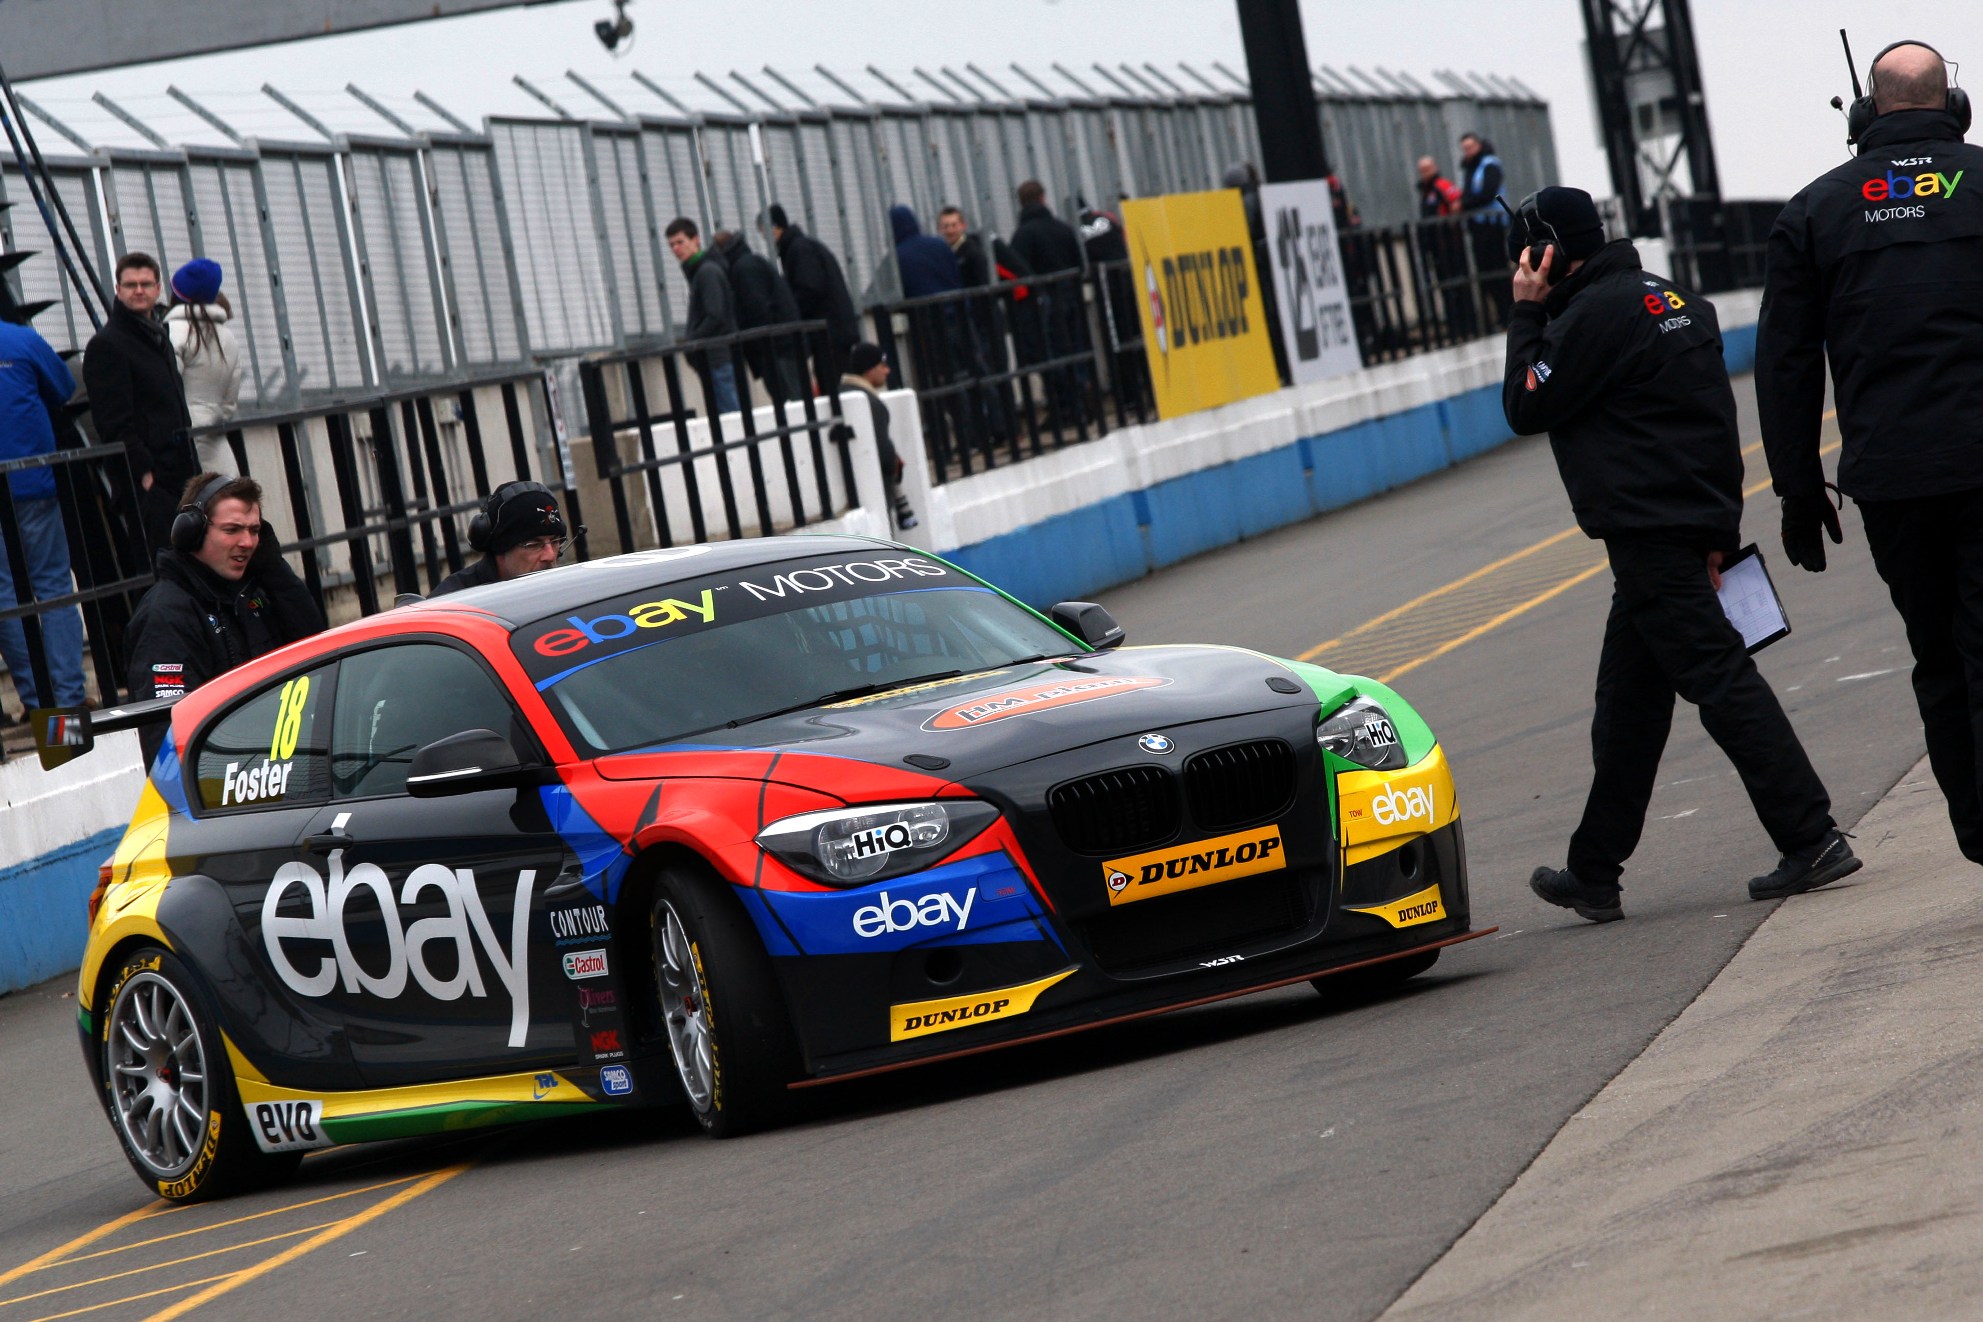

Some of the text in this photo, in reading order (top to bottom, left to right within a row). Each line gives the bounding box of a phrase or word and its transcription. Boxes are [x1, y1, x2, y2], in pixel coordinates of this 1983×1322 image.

[1890, 156, 1932, 166] WSR
[1862, 169, 1964, 201] ebay
[1864, 205, 1926, 222] MOTORS
[533, 558, 947, 657] ebay MOTORS
[154, 674, 185, 684] NGK
[155, 689, 184, 698] SAMCO
[269, 675, 310, 762] 18
[955, 697, 1026, 723] HM
[1366, 720, 1397, 746] HiQ
[221, 758, 294, 806] Foster
[1348, 809, 1363, 818] TOW
[1372, 782, 1434, 825] ebay
[853, 824, 912, 857] HiQ
[1138, 836, 1281, 886] DUNLOP
[550, 904, 609, 938] CONTOUR
[852, 887, 977, 938] ebay
[1397, 900, 1438, 922] DUNLOP
[261, 812, 537, 1048] ebay
[575, 955, 606, 974] Castrol
[903, 998, 1010, 1031] DUNLOP
[590, 1030, 624, 1052] NGK
[255, 1101, 317, 1144] evo
